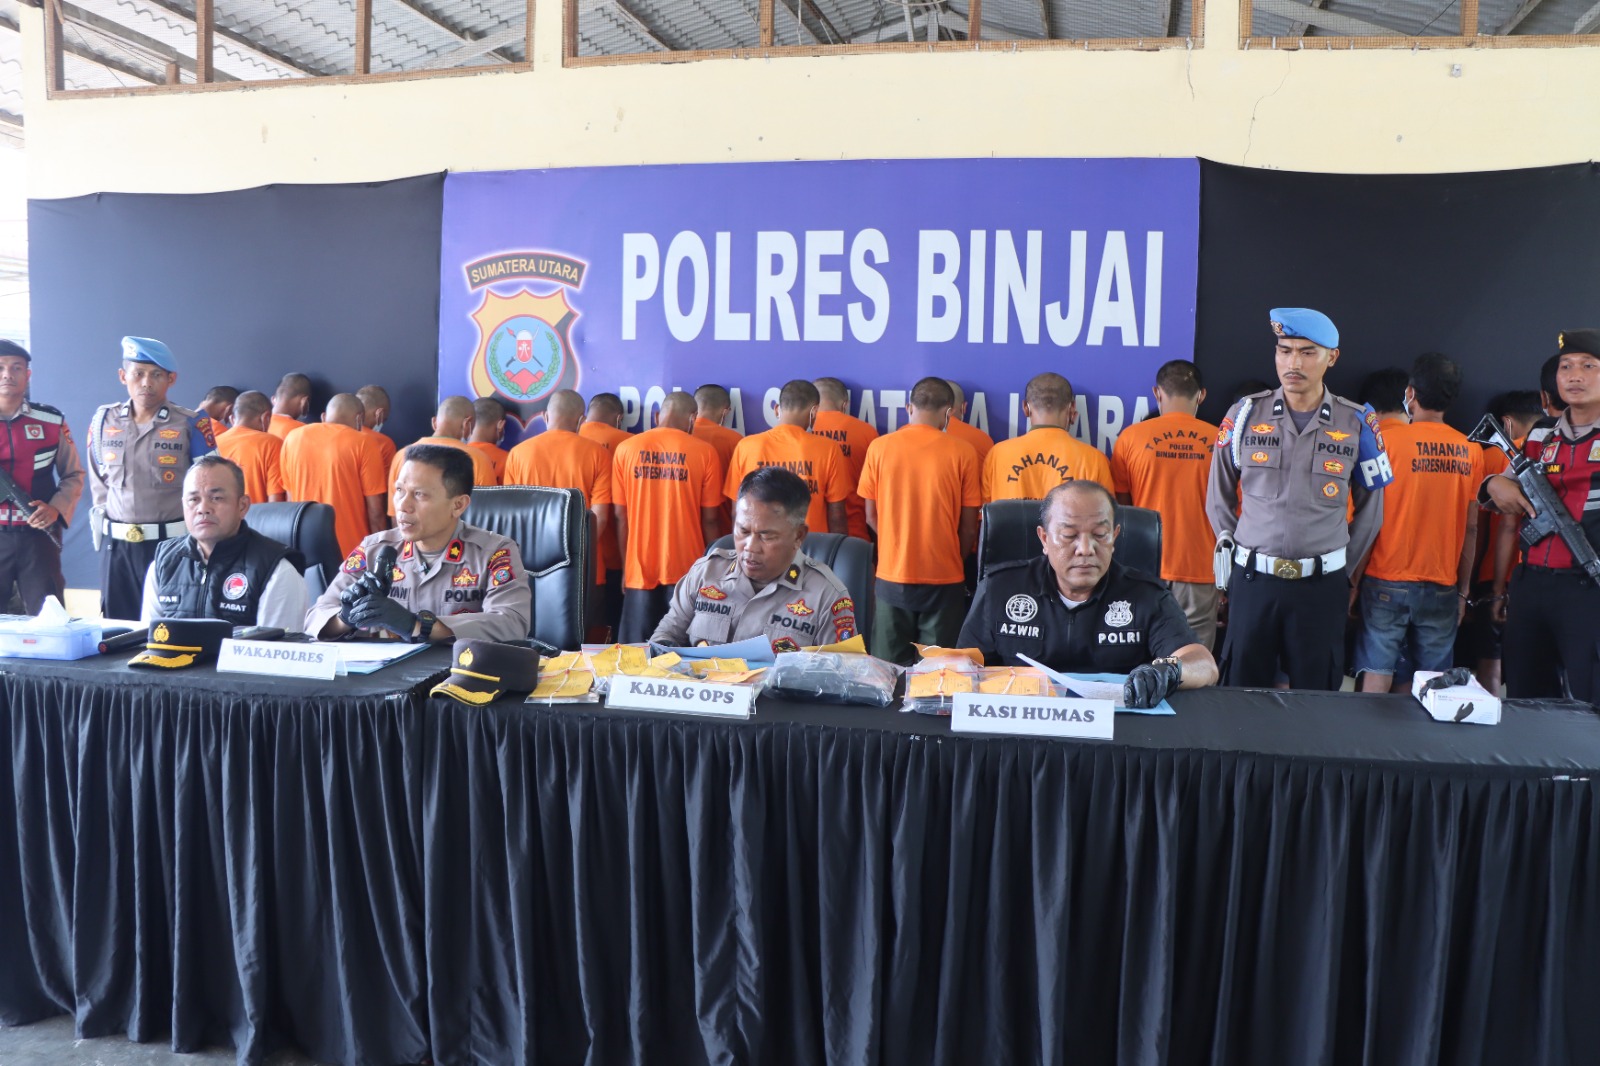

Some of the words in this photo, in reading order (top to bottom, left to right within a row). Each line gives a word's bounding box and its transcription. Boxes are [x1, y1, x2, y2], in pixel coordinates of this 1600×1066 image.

[471, 259, 536, 283] SUMATERA
[539, 259, 579, 282] UTARA
[621, 228, 890, 343] POLRES
[916, 230, 1164, 347] BINJAI
[154, 442, 183, 451] POLRI
[1244, 435, 1280, 447] ERWIN
[1318, 442, 1354, 457] POLRI
[1416, 442, 1469, 459] TAHANAN
[640, 450, 686, 466] TAHANAN
[445, 588, 484, 603] POLRI
[220, 602, 247, 612] KASAT
[771, 614, 816, 636] POLRI
[1000, 622, 1040, 638] AZWIR
[1098, 631, 1140, 644] POLRI
[233, 645, 325, 664] WAKAPOLRES
[629, 681, 695, 700] KABAG
[699, 688, 735, 704] OPS
[967, 703, 1018, 719] KASI
[1022, 706, 1096, 723] HUMAS
